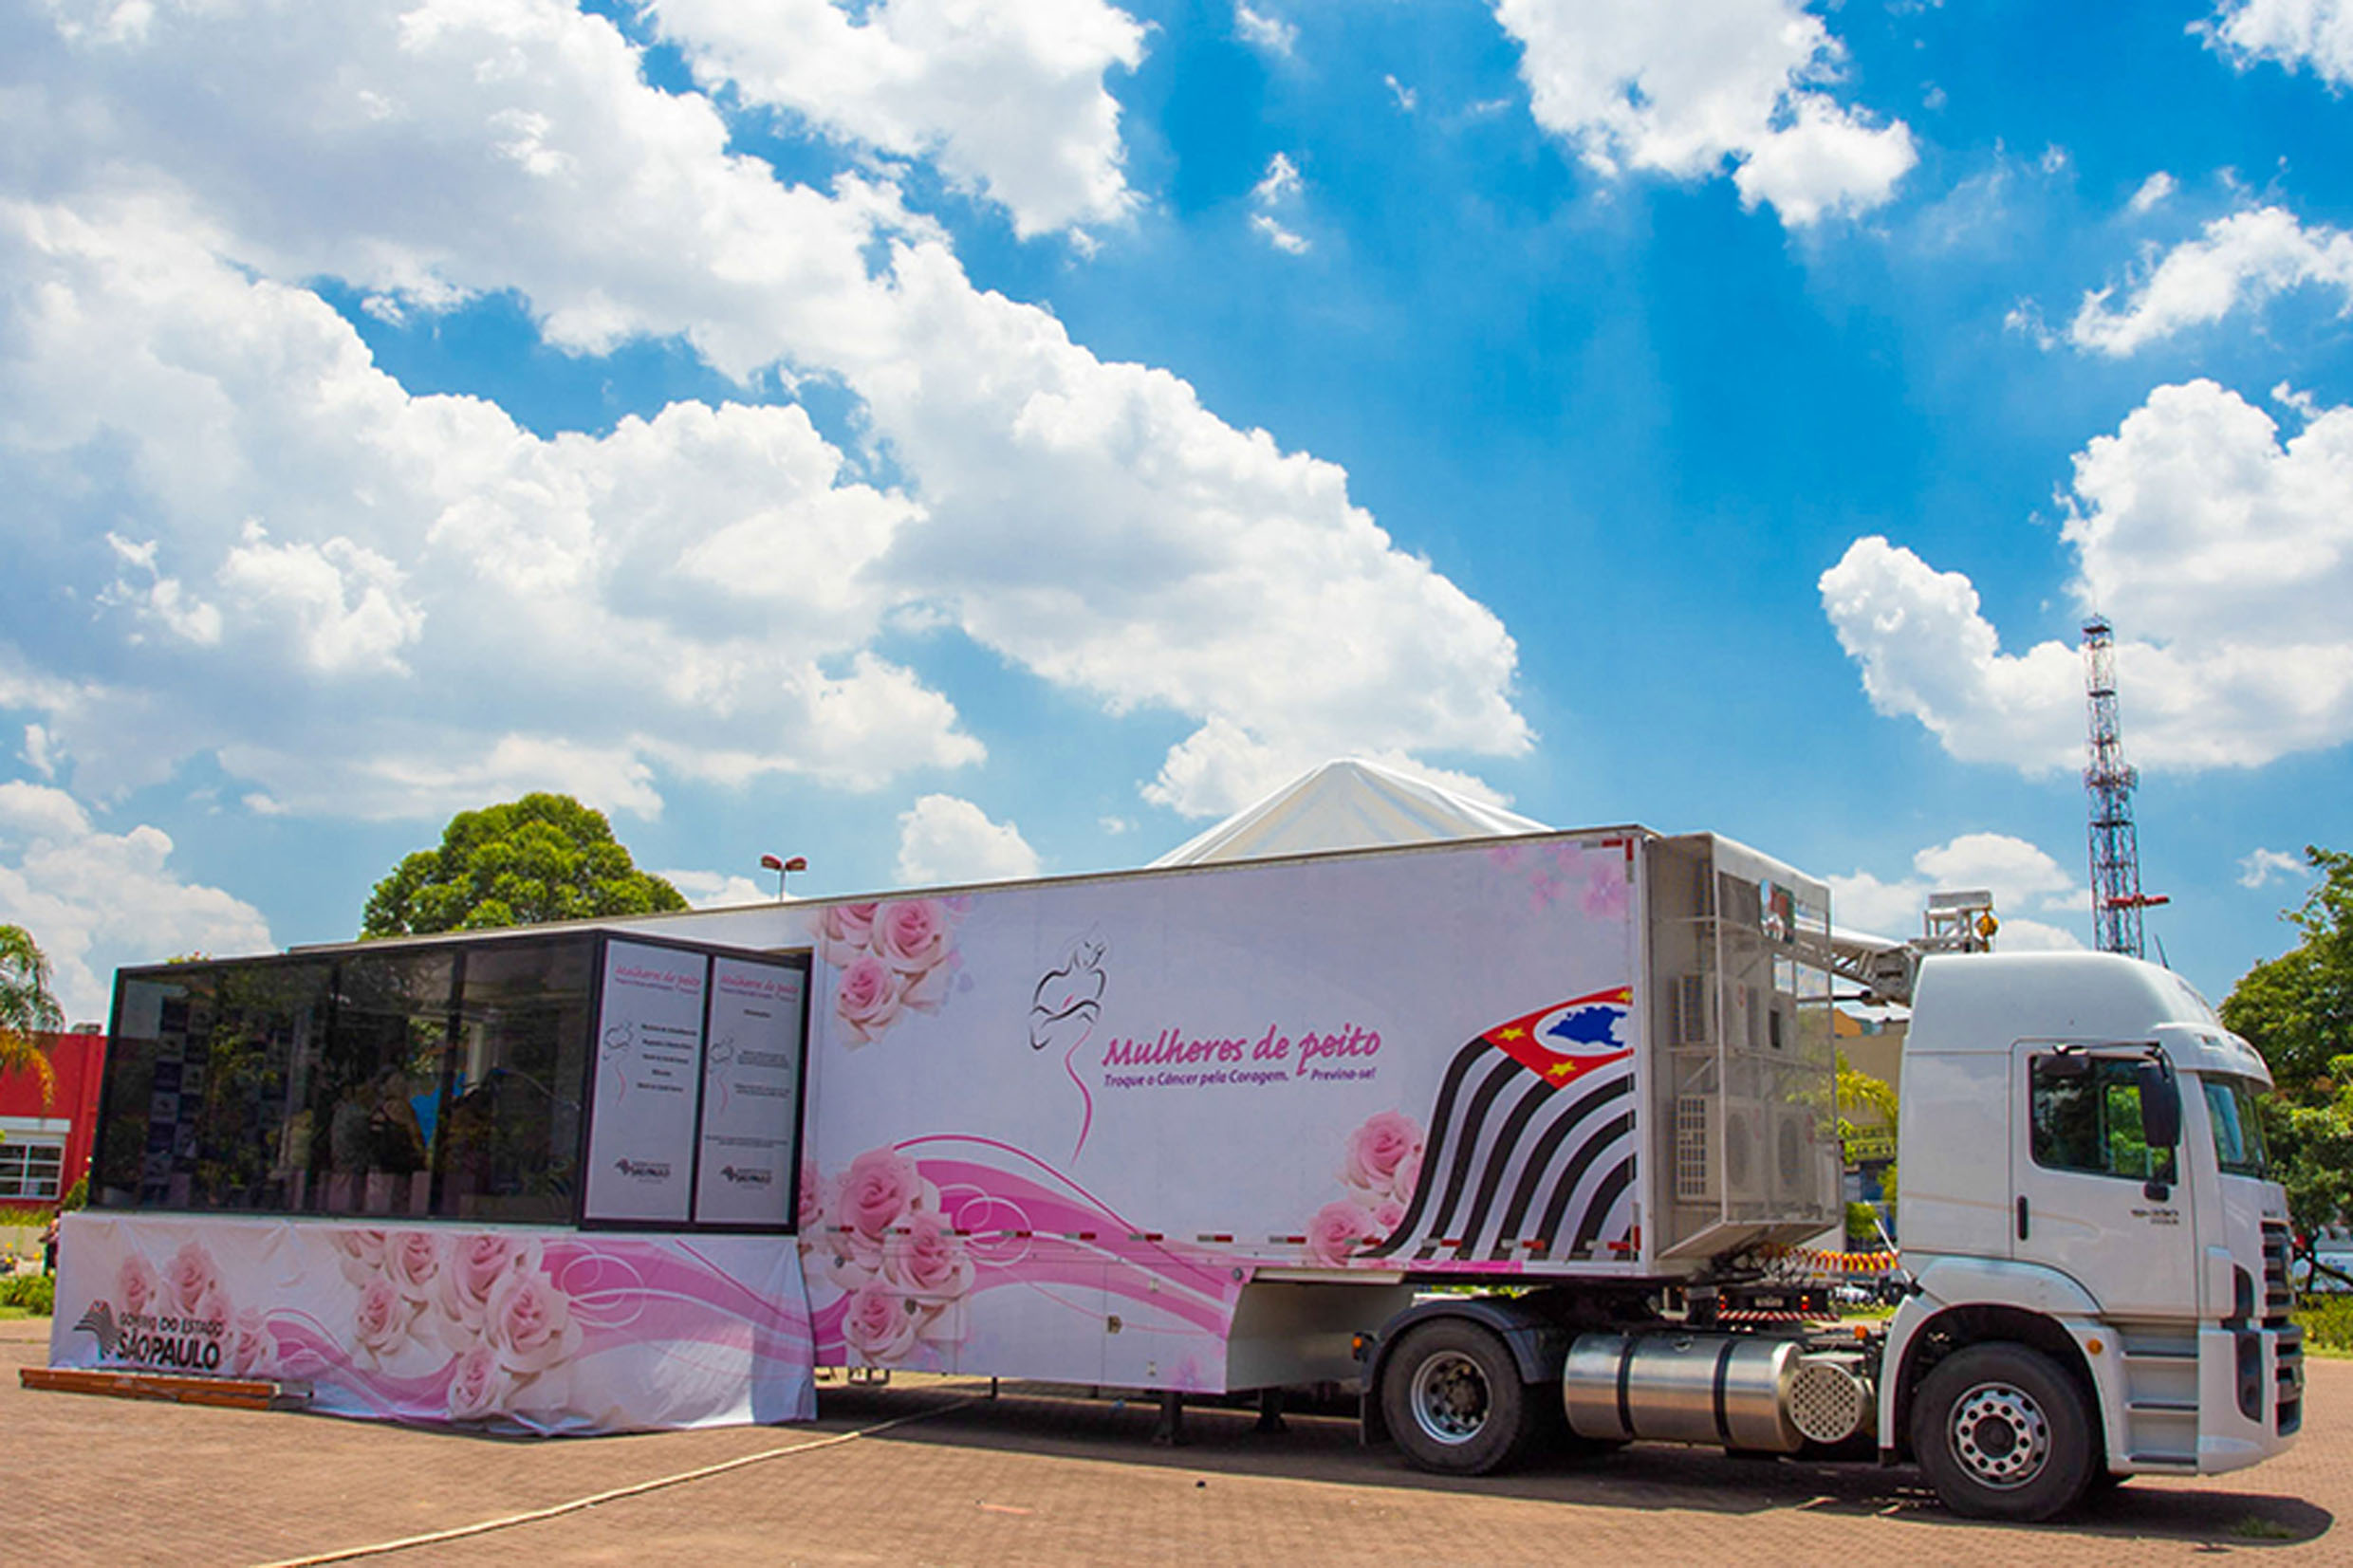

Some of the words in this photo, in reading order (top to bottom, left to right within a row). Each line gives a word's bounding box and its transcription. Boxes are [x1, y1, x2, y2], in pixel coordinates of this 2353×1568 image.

[1102, 1028, 1248, 1066] Mulheres
[1253, 1024, 1289, 1061] de
[1296, 1023, 1381, 1077] peito
[1104, 1074, 1145, 1089] Troque
[1199, 1069, 1227, 1087] pela
[159, 1317, 179, 1331] DO
[181, 1317, 224, 1337] ESTADO
[149, 1337, 221, 1371] PAULO
